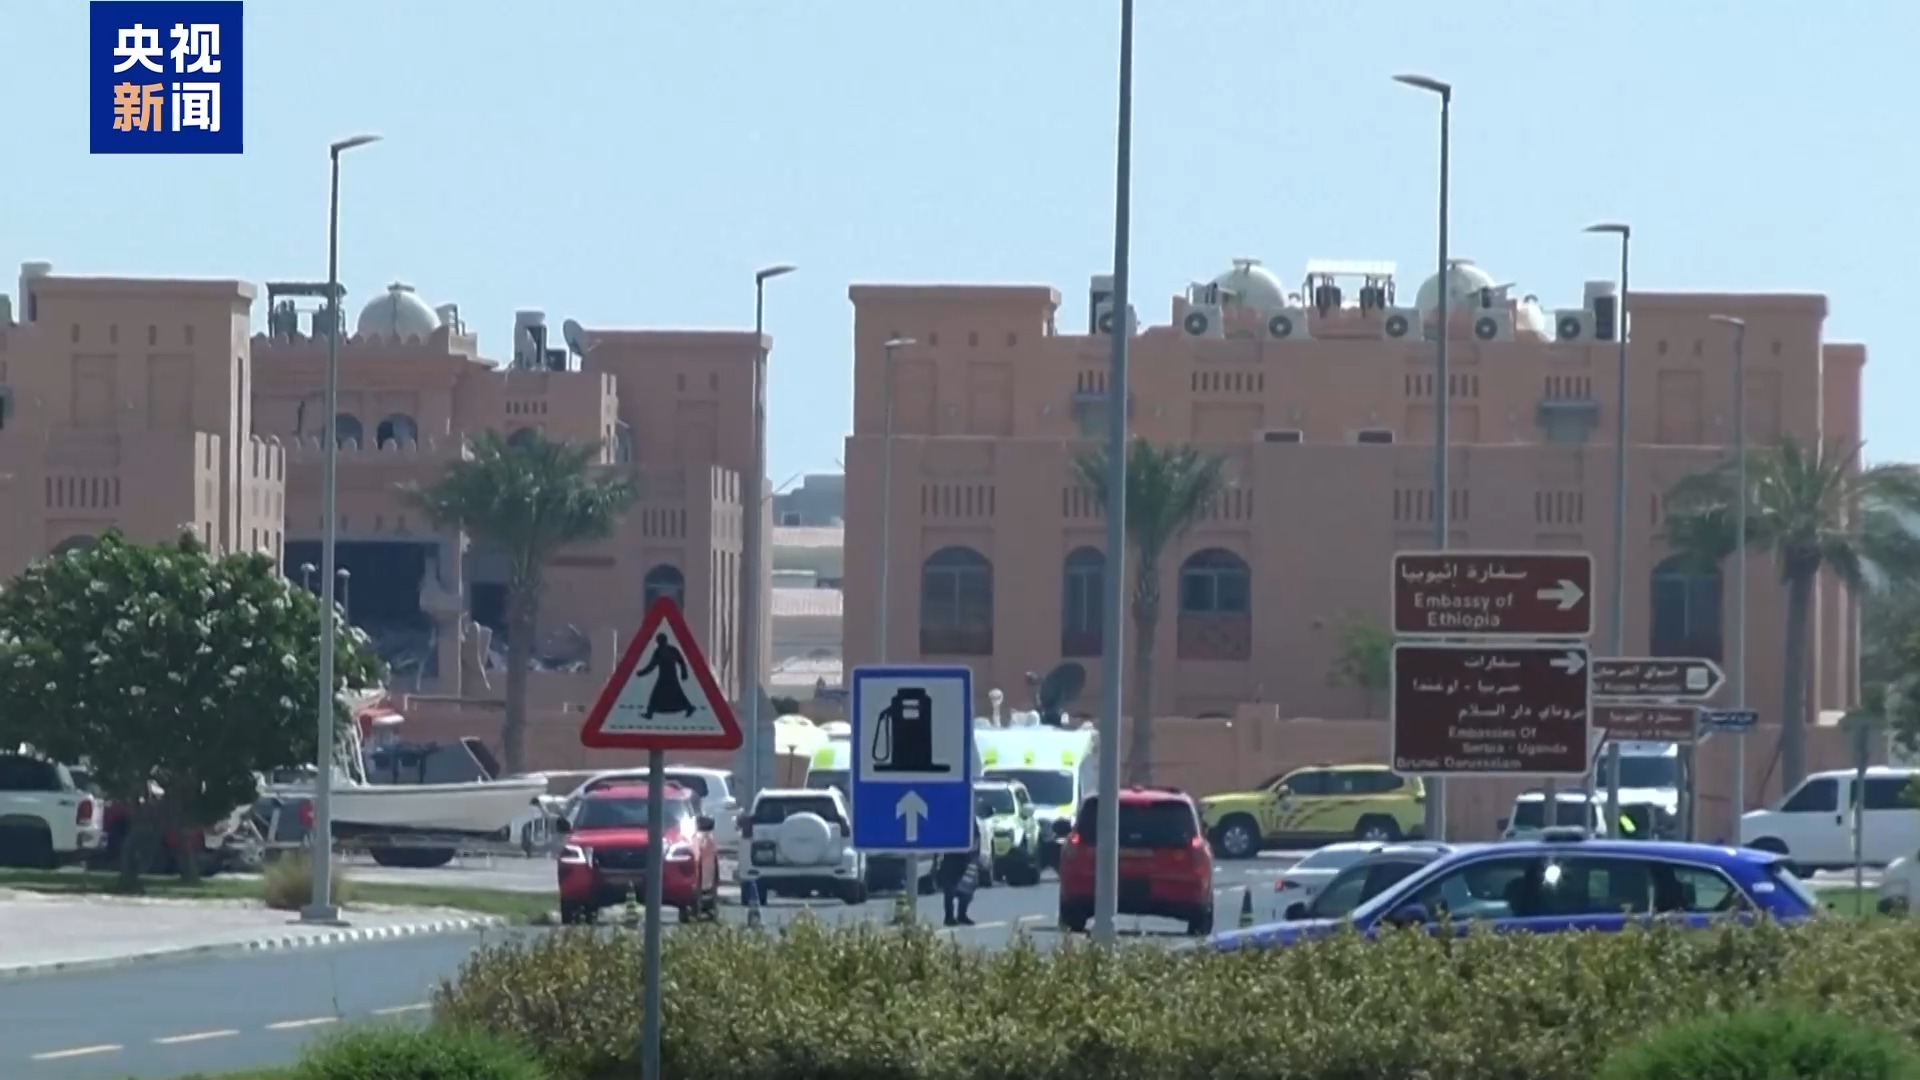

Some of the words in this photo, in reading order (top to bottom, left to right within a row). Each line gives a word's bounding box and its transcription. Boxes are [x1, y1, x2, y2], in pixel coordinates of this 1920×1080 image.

[1466, 562, 1528, 584] سفارة
[1414, 592, 1491, 611] Embassy
[1495, 592, 1515, 608] of
[1427, 611, 1501, 629] Ethiopia
[1464, 655, 1521, 671] سفارات
[1478, 679, 1521, 695] صربيا
[1457, 703, 1506, 722] السلام
[1510, 703, 1532, 720] دار
[1447, 725, 1517, 739] Embassies
[1462, 742, 1505, 754] Serbia
[1516, 743, 1568, 756] Uganda
[1396, 756, 1440, 769] Brunei
